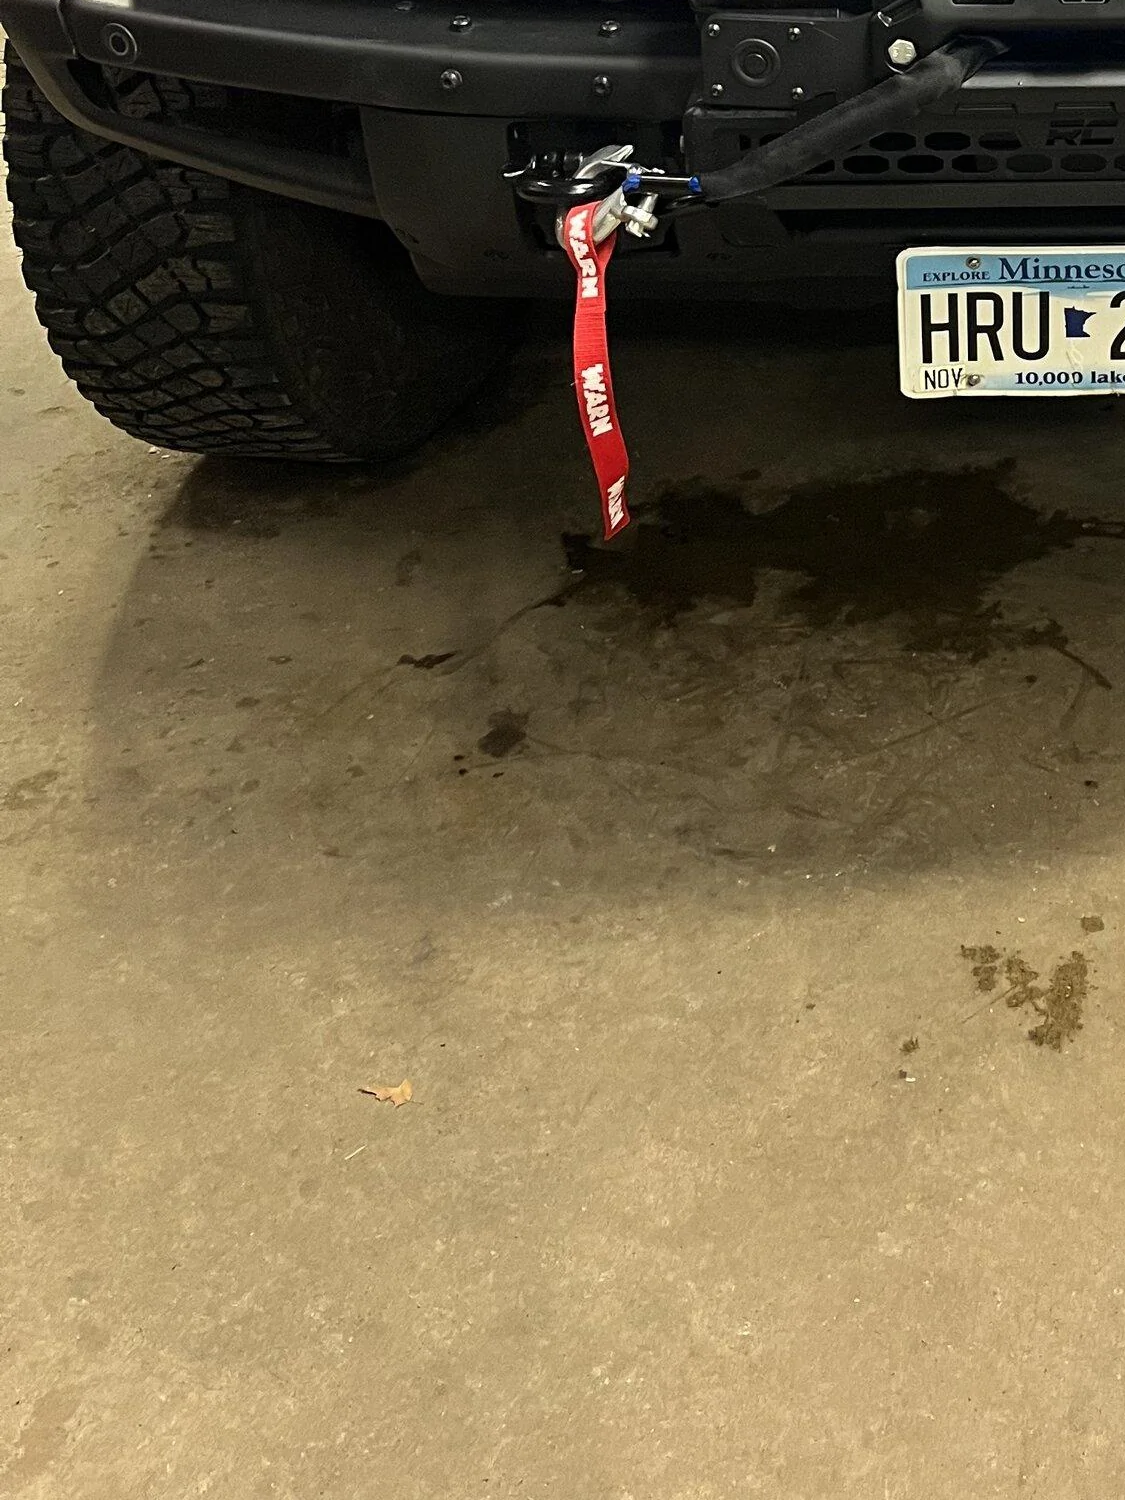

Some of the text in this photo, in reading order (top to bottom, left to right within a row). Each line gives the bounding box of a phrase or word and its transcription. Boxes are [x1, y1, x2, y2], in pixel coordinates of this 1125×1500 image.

[569, 209, 599, 299] WARN
[923, 271, 991, 282] EXPLORE
[920, 291, 1050, 364] HRU
[581, 363, 614, 438] WARN
[924, 367, 964, 390] NOV
[1014, 371, 1083, 385] 10,000
